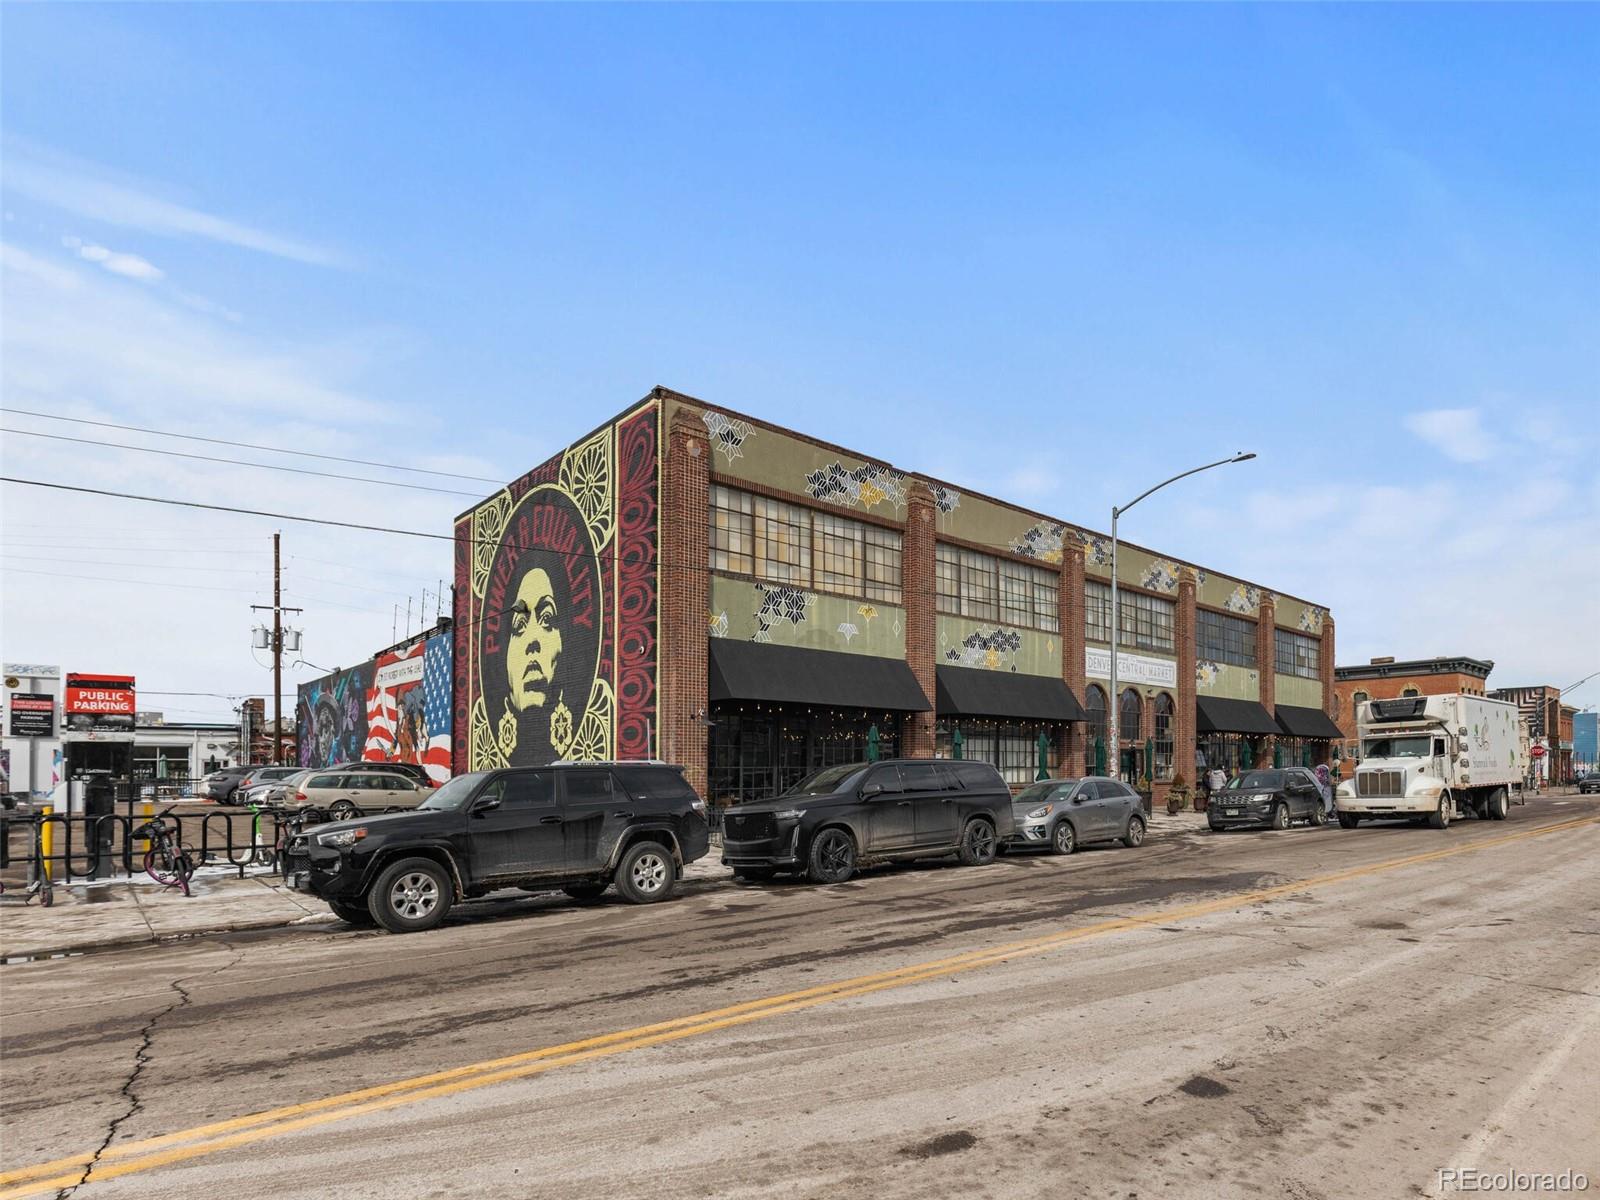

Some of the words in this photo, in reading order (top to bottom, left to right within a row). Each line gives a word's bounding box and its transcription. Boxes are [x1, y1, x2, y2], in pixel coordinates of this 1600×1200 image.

[484, 534, 519, 655] POWER
[533, 504, 593, 630] EQUALITY
[600, 545, 613, 682] PEOPLE
[1088, 656, 1111, 672] DENVE
[1117, 660, 1146, 676] CENTRAL
[1148, 664, 1173, 681] MARKET
[73, 700, 129, 711] PARKING
[79, 690, 125, 701] PUBLIC
